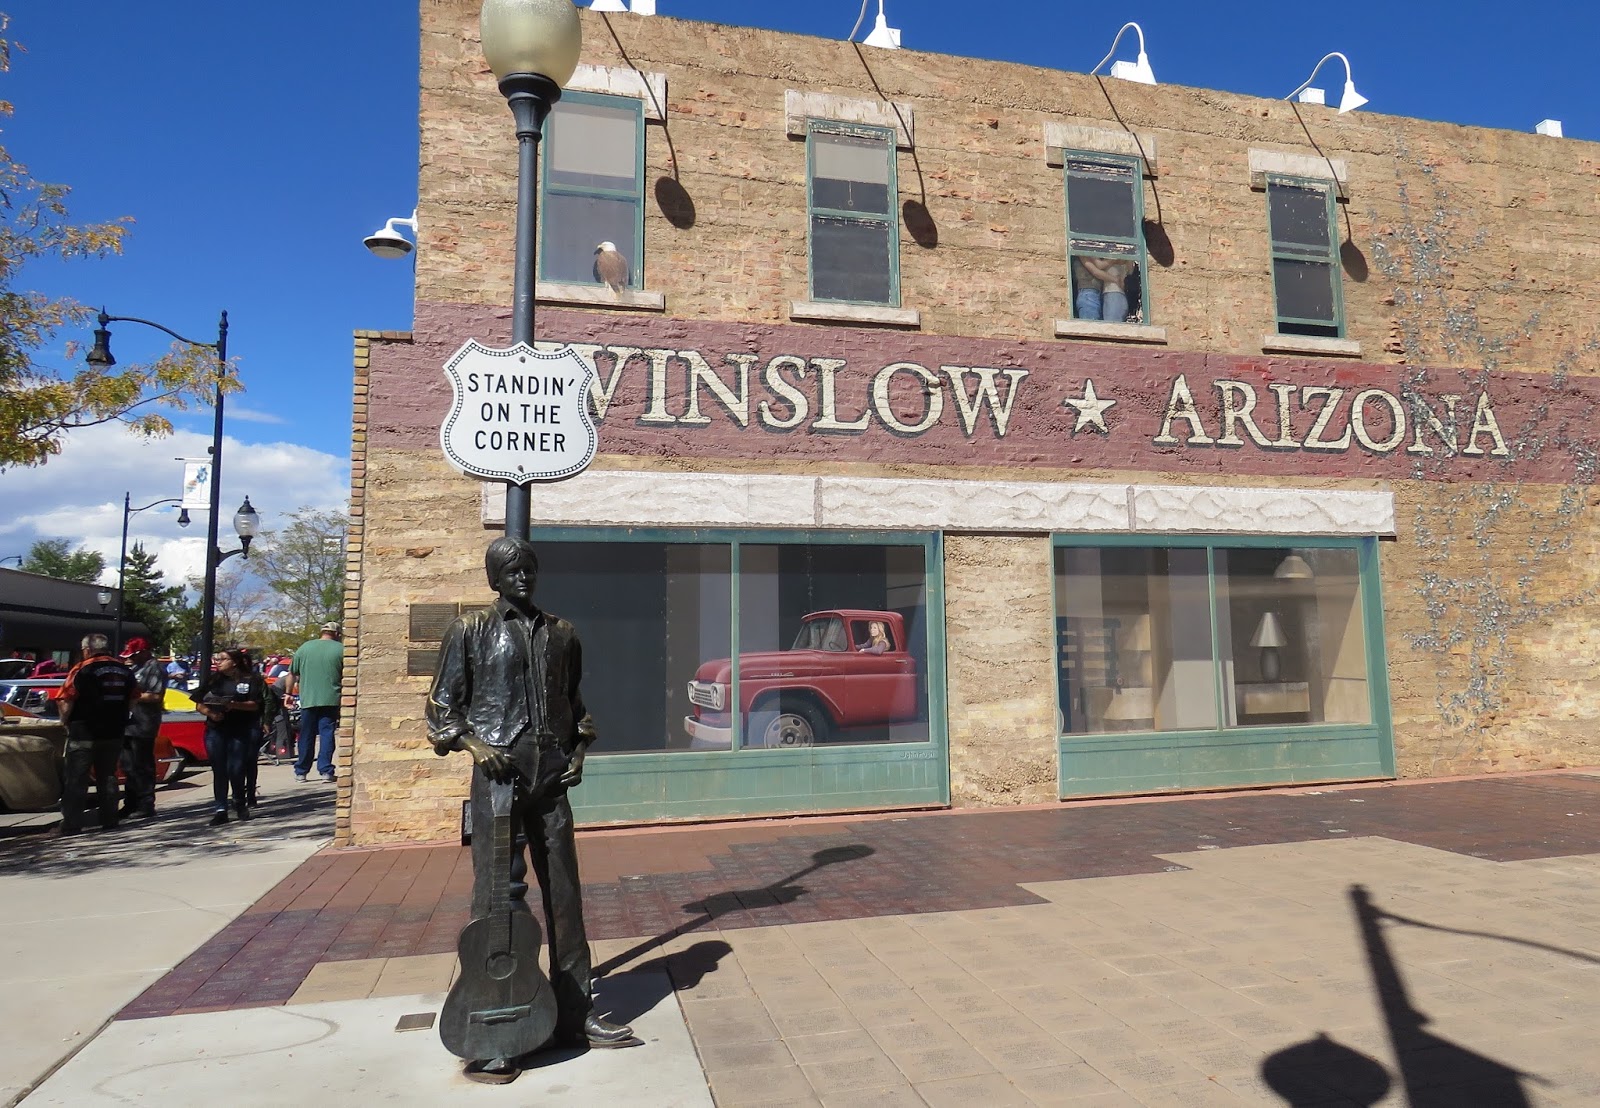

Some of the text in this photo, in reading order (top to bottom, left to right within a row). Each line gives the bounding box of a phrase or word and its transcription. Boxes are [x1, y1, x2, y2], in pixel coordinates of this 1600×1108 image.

[467, 372, 575, 397] STANDIN'
[534, 340, 1510, 457] WINSLOW ARIZONA
[481, 402, 561, 425] ON THE
[474, 430, 566, 453] CORNER
